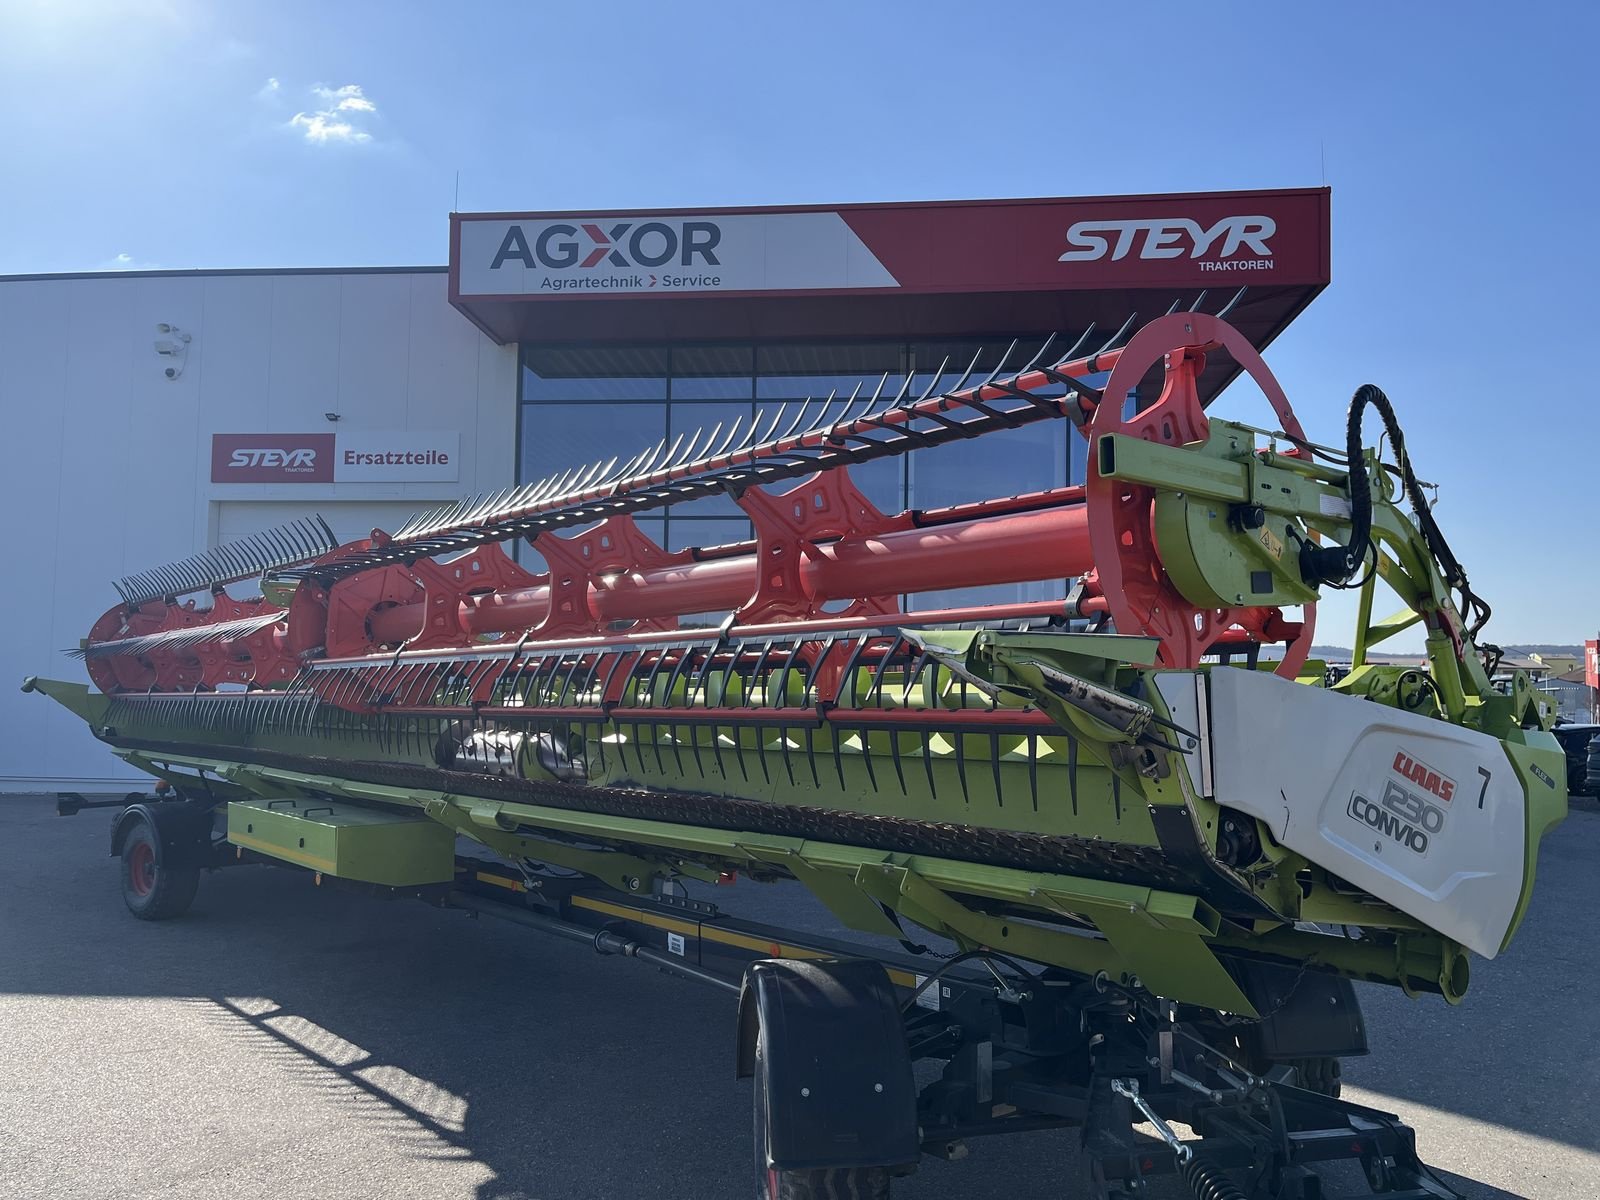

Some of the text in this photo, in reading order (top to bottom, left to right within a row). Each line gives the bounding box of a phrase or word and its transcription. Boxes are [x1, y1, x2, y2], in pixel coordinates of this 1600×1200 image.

[489, 221, 722, 269] AGXOR
[1058, 214, 1277, 262] STEYR
[540, 274, 721, 290] Agrartechnik Service
[1198, 259, 1274, 272] TRAKTOREN
[228, 448, 317, 467] STEYR
[344, 450, 449, 466] Ersatzteile
[1392, 751, 1454, 802] CLAAS
[1477, 765, 1492, 810] 7
[1535, 767, 1548, 782] FLEX
[1352, 795, 1428, 854] CONVIO
[1381, 780, 1444, 834] 1230
